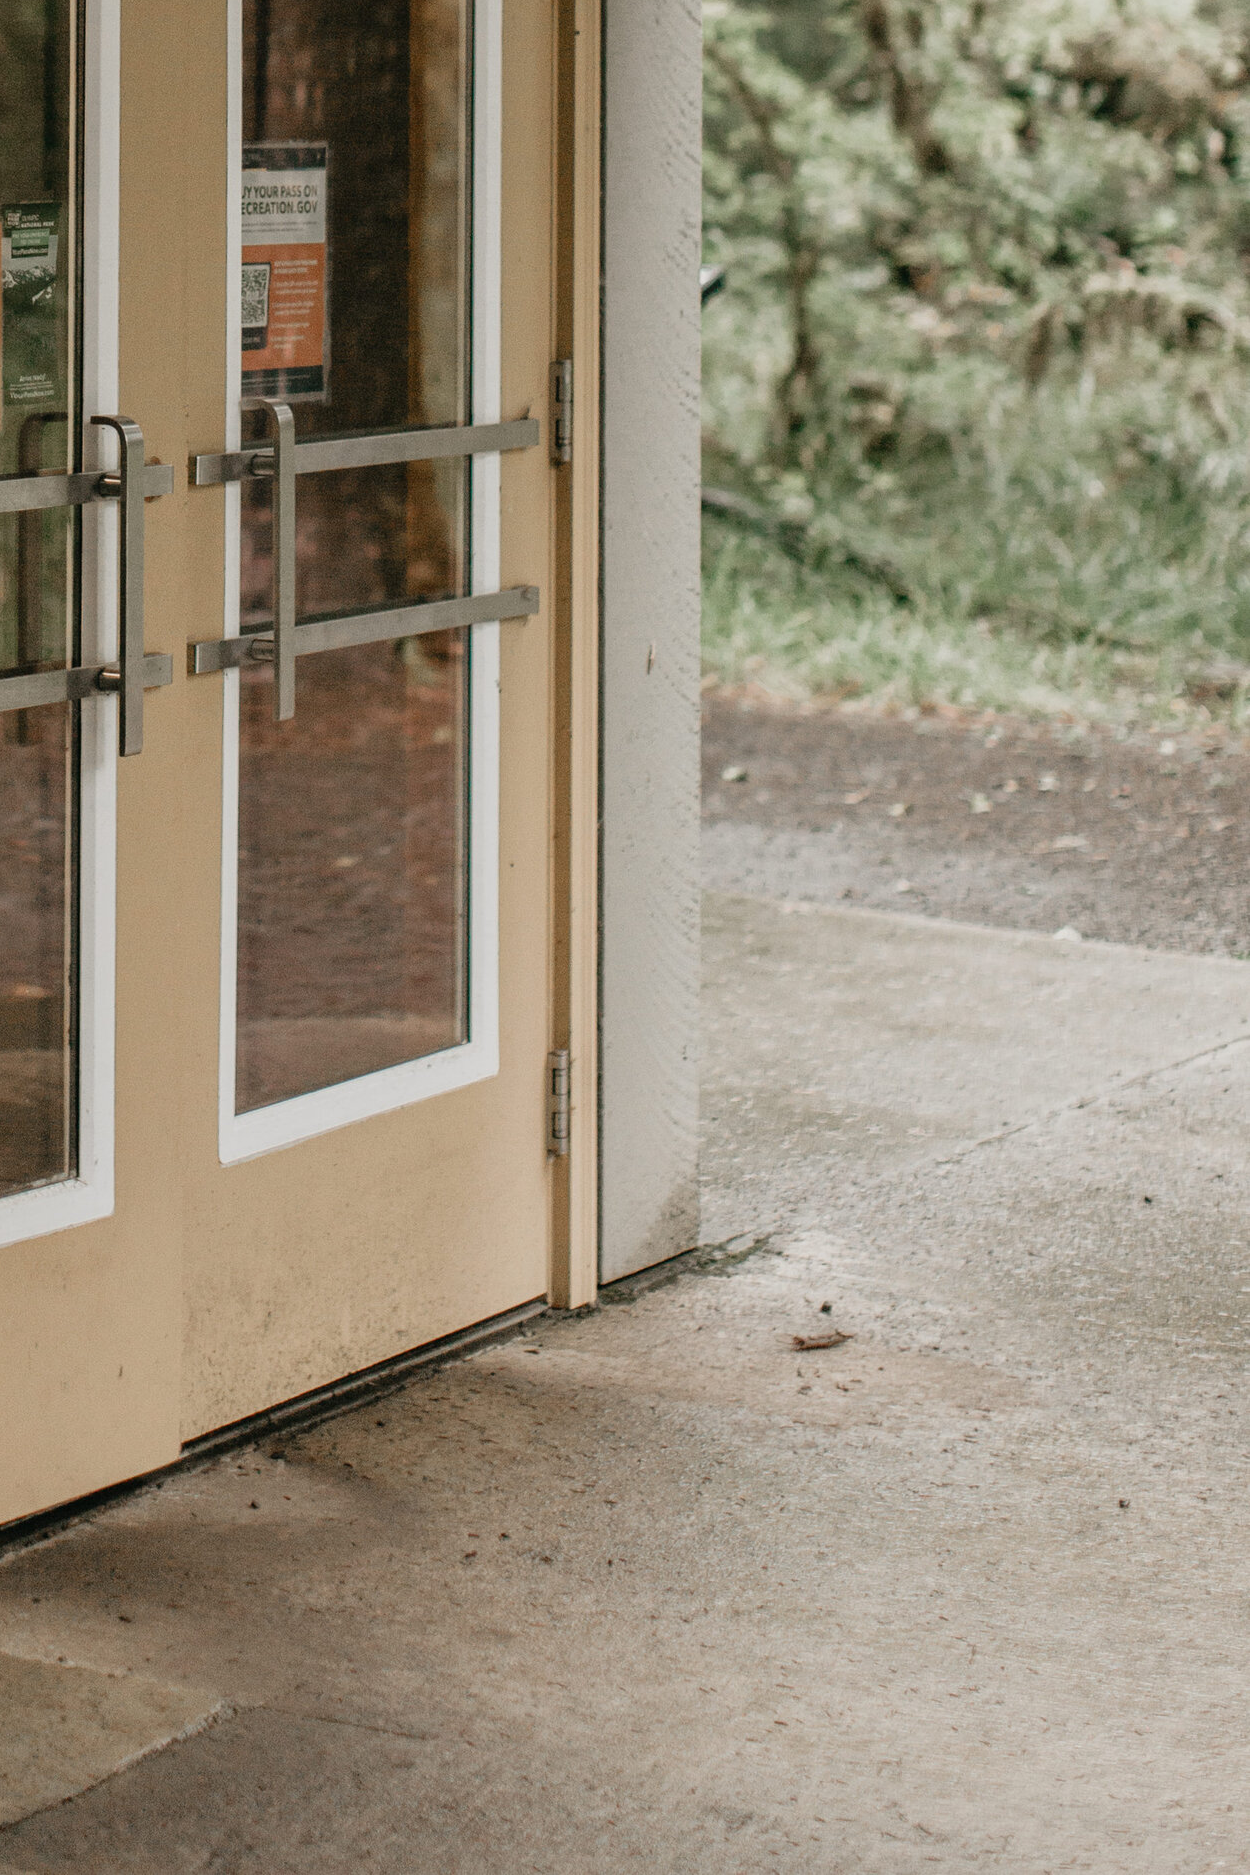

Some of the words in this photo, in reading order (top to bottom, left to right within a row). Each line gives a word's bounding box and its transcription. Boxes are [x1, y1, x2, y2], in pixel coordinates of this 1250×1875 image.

[253, 185, 278, 198] YOUR
[280, 185, 301, 198] PASS
[303, 184, 318, 198] ON
[241, 200, 318, 215] ECREATION.GOV
